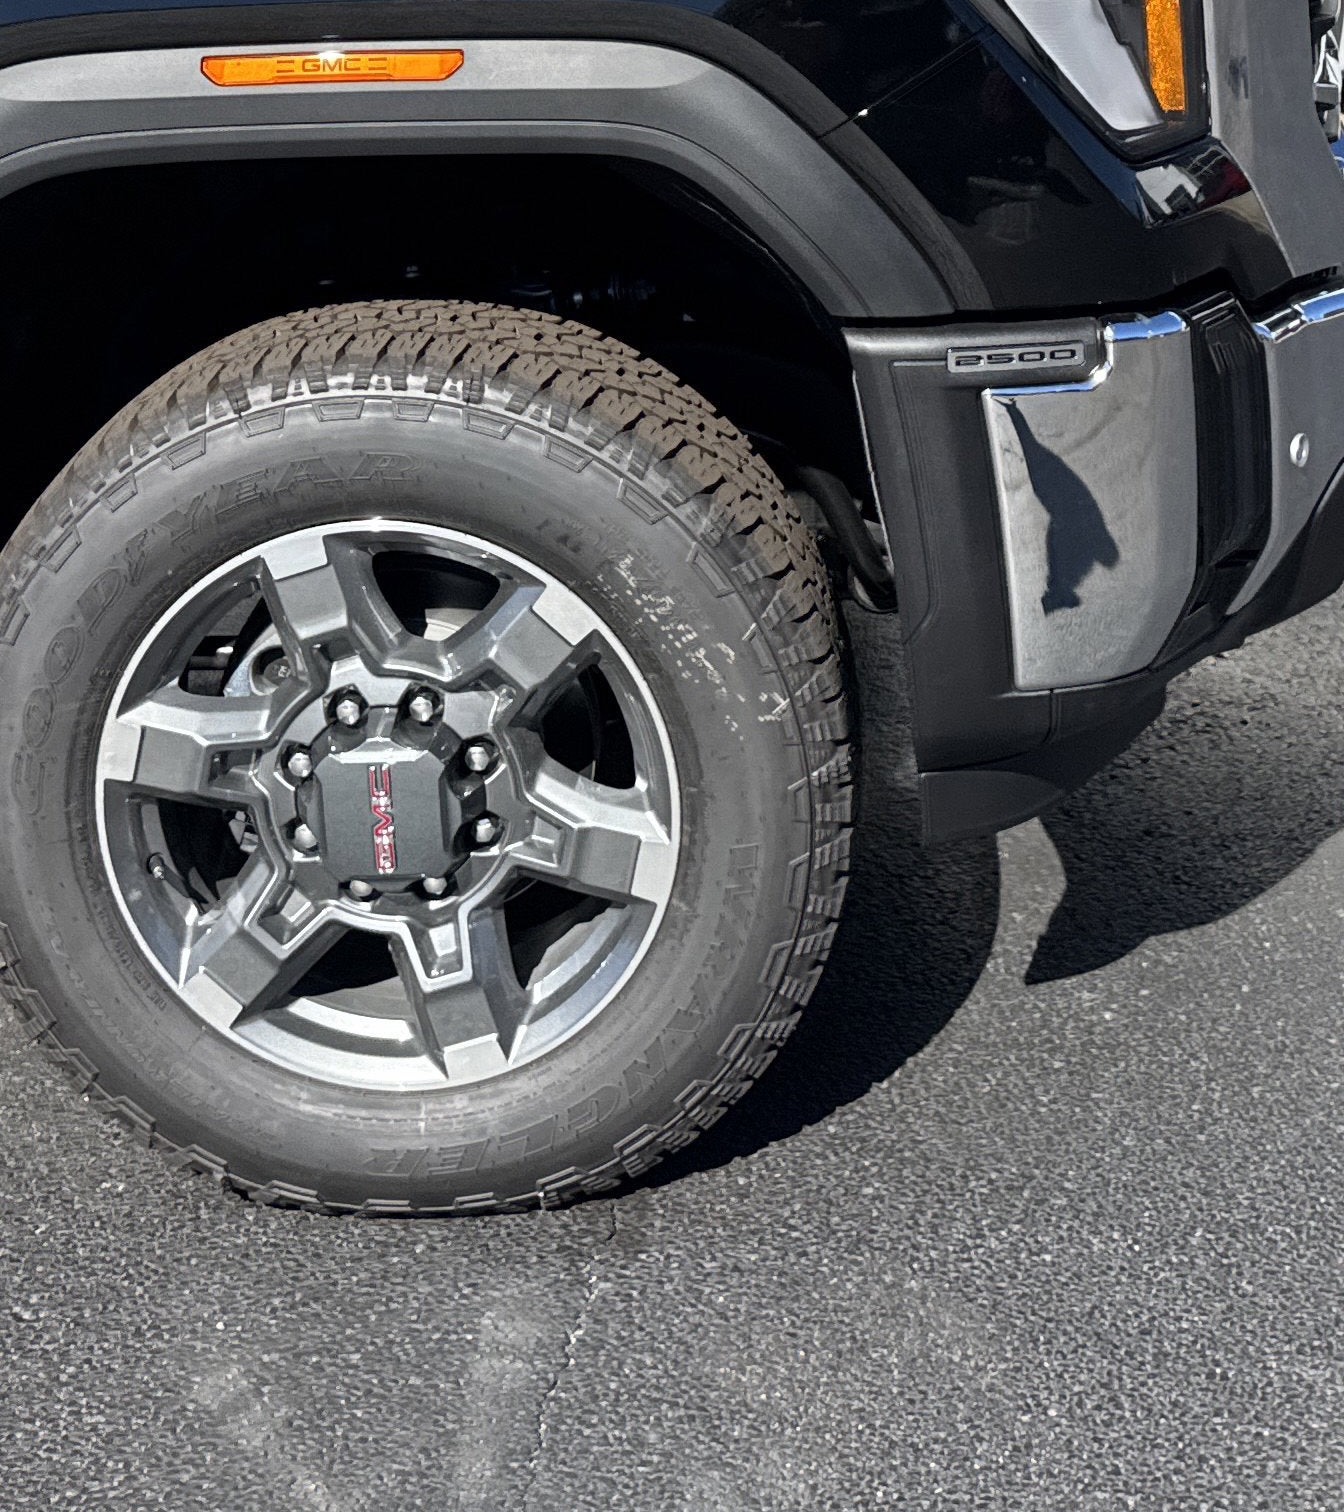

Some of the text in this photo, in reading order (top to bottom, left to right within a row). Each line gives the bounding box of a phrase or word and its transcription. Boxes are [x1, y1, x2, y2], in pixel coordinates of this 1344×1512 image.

[301, 56, 362, 73] GMC
[955, 348, 1077, 367] 2500
[11, 450, 423, 816] GOODYEAR
[368, 763, 397, 875] GMC
[364, 842, 760, 1178] WRANGLER
